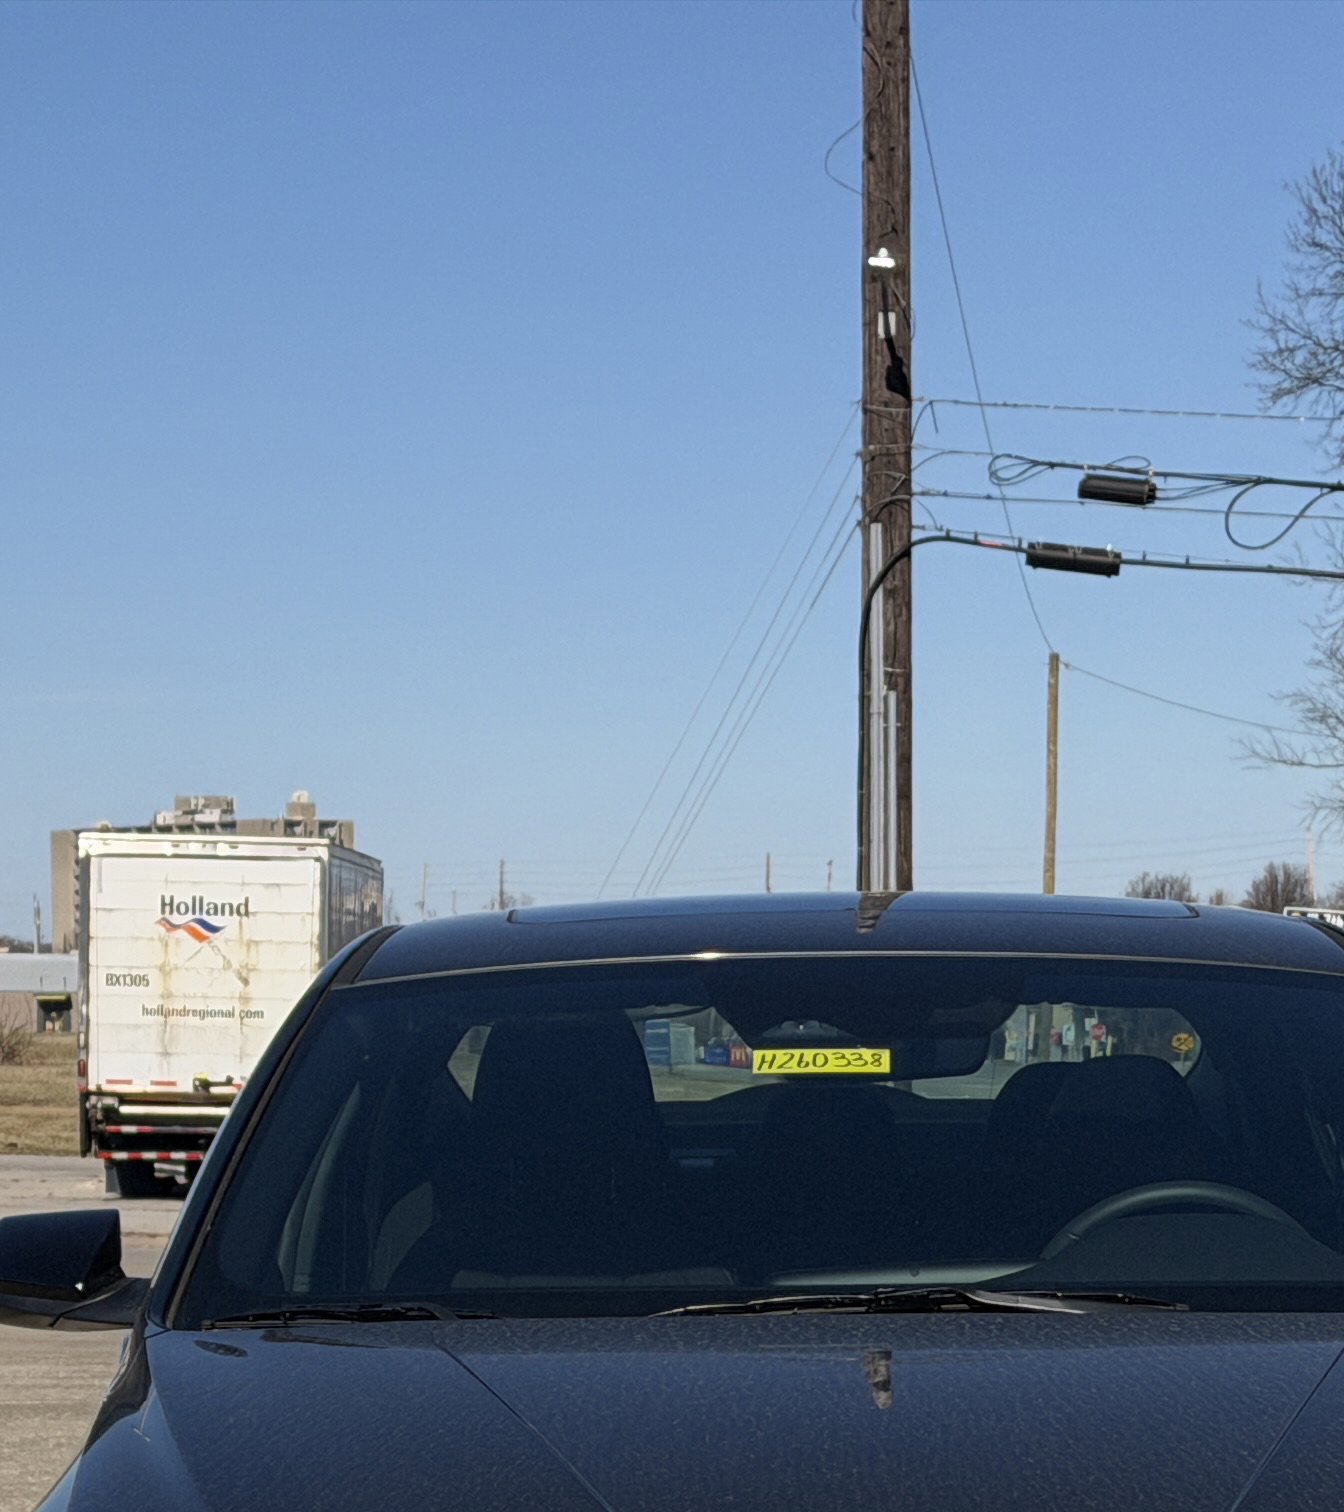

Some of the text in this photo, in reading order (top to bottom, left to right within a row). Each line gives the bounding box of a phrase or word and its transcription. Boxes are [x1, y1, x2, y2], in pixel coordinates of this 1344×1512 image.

[160, 894, 250, 918] Holland
[141, 1003, 264, 1021] hollandregionalcom
[756, 1052, 883, 1071] H260338
